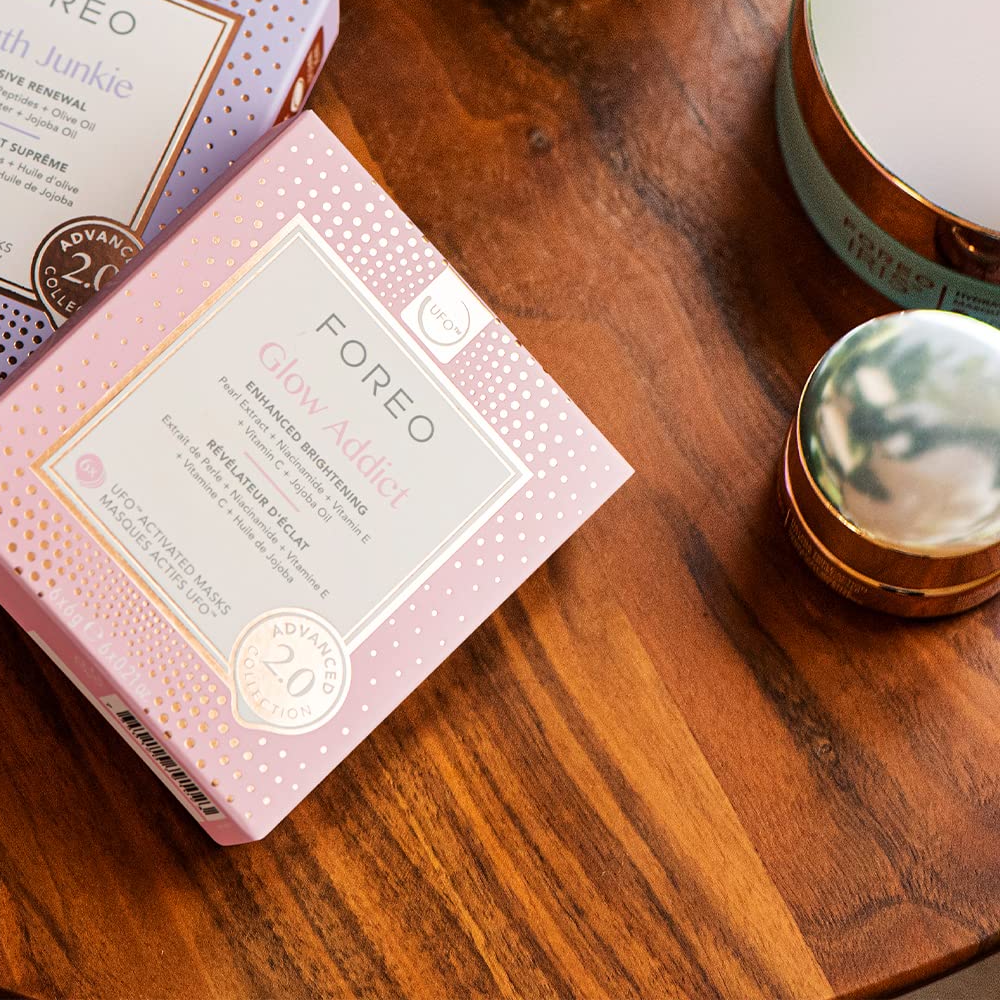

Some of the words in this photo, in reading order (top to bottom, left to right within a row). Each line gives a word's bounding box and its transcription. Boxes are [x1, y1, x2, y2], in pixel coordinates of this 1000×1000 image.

[27, 81, 86, 112] RENEWAL
[35, 46, 134, 99] Junkie
[25, 113, 59, 132] Jojoba
[61, 127, 78, 139] Oil
[51, 108, 78, 125] Olive
[80, 119, 96, 132] Oil
[9, 143, 69, 173] SUPRÊME
[17, 162, 44, 180] Huile
[24, 182, 38, 192] de
[39, 188, 74, 207] Jojoba
[60, 229, 133, 264] ADVANC
[45, 266, 82, 313] COLLE
[316, 313, 435, 443] FOREO
[218, 376, 242, 401] Pearl
[239, 399, 269, 433] Extract
[276, 439, 324, 494] Niacinamide
[332, 500, 362, 536] Vitamin
[361, 534, 371, 544] E
[245, 380, 301, 442] ENHANCED
[300, 441, 368, 516] BRIGHTENING
[259, 342, 328, 415] Glow
[322, 420, 410, 509] Addict
[161, 414, 190, 446] Extrait
[189, 446, 201, 459] de
[201, 457, 223, 482] Perle
[229, 489, 278, 544] Niacinamide
[287, 550, 320, 591] Vitamine
[320, 589, 330, 599] E
[206, 439, 269, 508] RÉVÉLATEUR
[245, 425, 275, 461] Vitamin
[274, 460, 285, 470] C
[289, 478, 317, 509] Jojoba
[317, 507, 333, 523] Oil
[99, 494, 152, 551] MASQUES
[148, 551, 188, 590] ACTIFS
[184, 458, 218, 499] Vitamine
[218, 498, 228, 508] C
[233, 515, 255, 540] Huile
[254, 540, 266, 553] de
[265, 553, 294, 584] Jojoba
[137, 516, 195, 576] ACTIVATED
[194, 574, 231, 615] MASKS
[273, 622, 337, 694] ADVANCED
